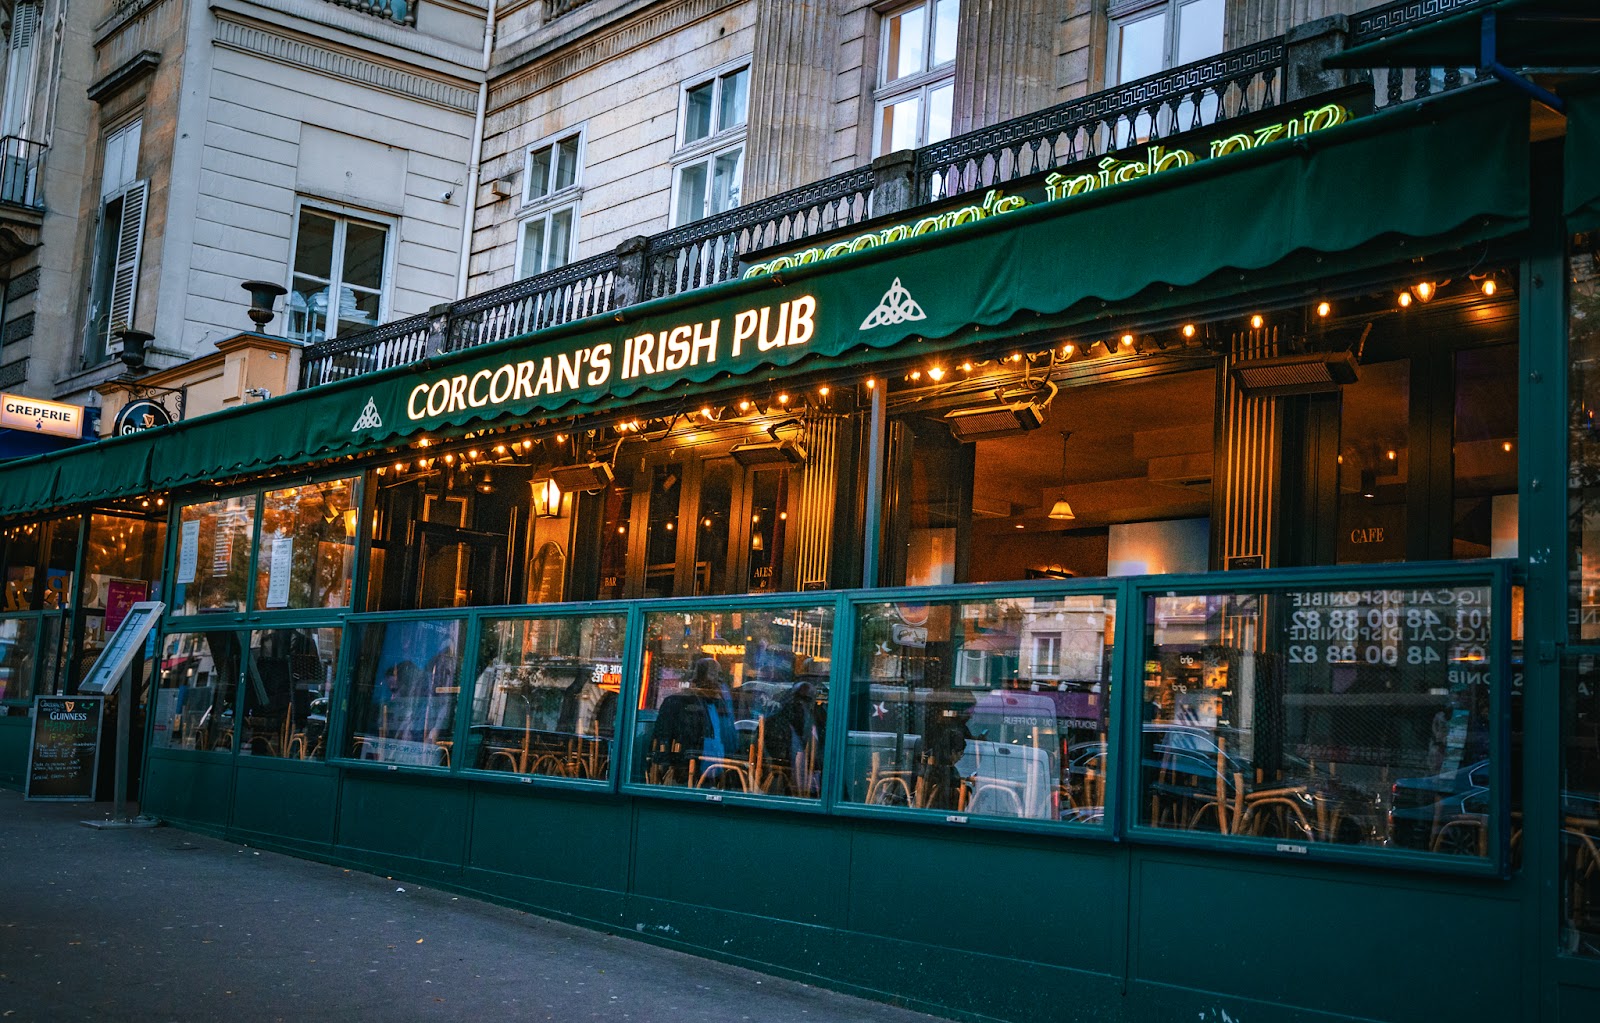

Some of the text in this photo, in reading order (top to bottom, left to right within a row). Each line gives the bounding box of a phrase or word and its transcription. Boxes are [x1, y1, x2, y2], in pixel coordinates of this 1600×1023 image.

[406, 295, 817, 421] CORCORAN'S IRISH PUB
[6, 403, 71, 422] CREPERIE
[1350, 527, 1385, 544] CAFE
[753, 566, 773, 578] ALES
[604, 576, 617, 587] BAR
[50, 711, 87, 720] GUINNESS
